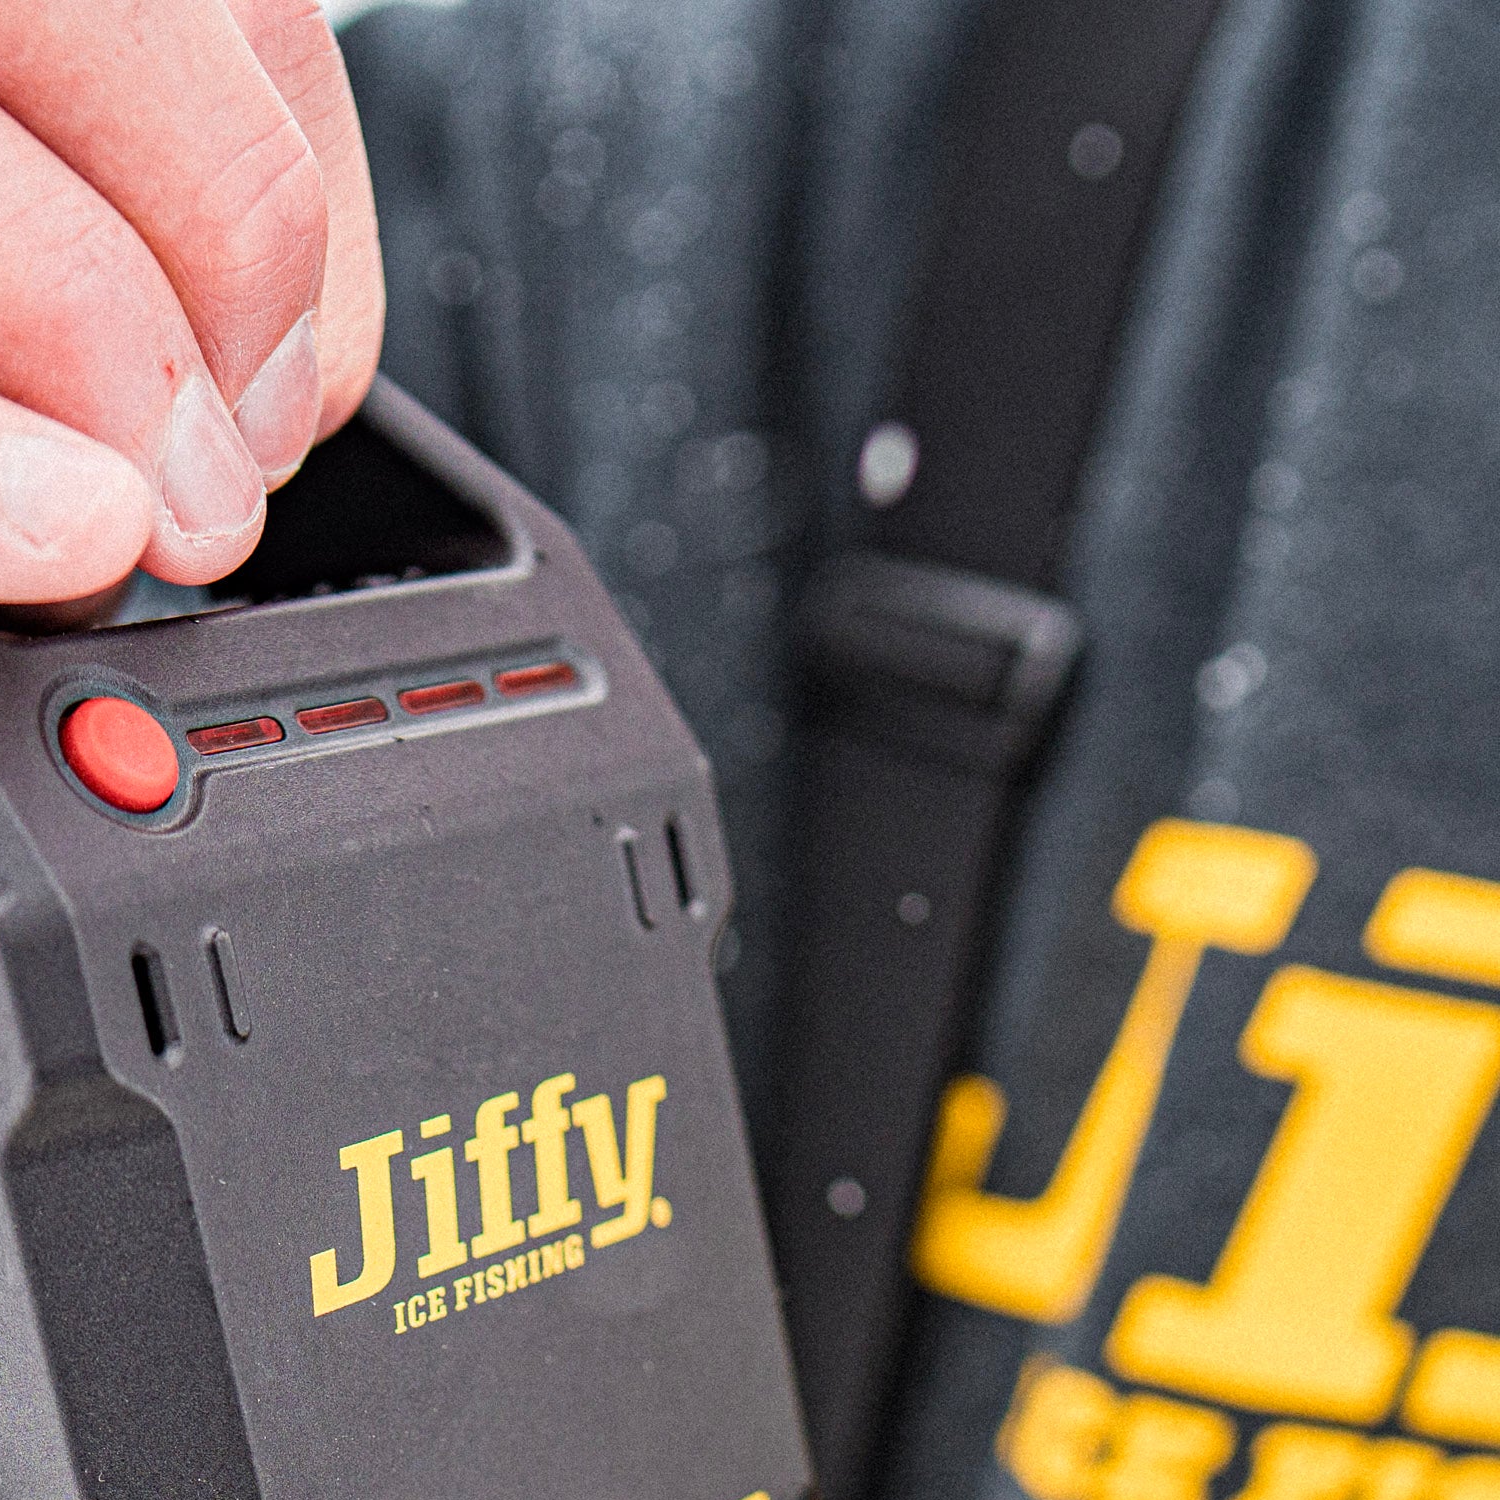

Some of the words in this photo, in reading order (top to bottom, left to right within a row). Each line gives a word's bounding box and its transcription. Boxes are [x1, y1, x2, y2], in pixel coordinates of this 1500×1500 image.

[310, 1072, 667, 1318] Jiffy
[911, 817, 1500, 1447] Ji
[393, 1286, 447, 1335] ICE
[454, 1233, 585, 1312] FISHING
